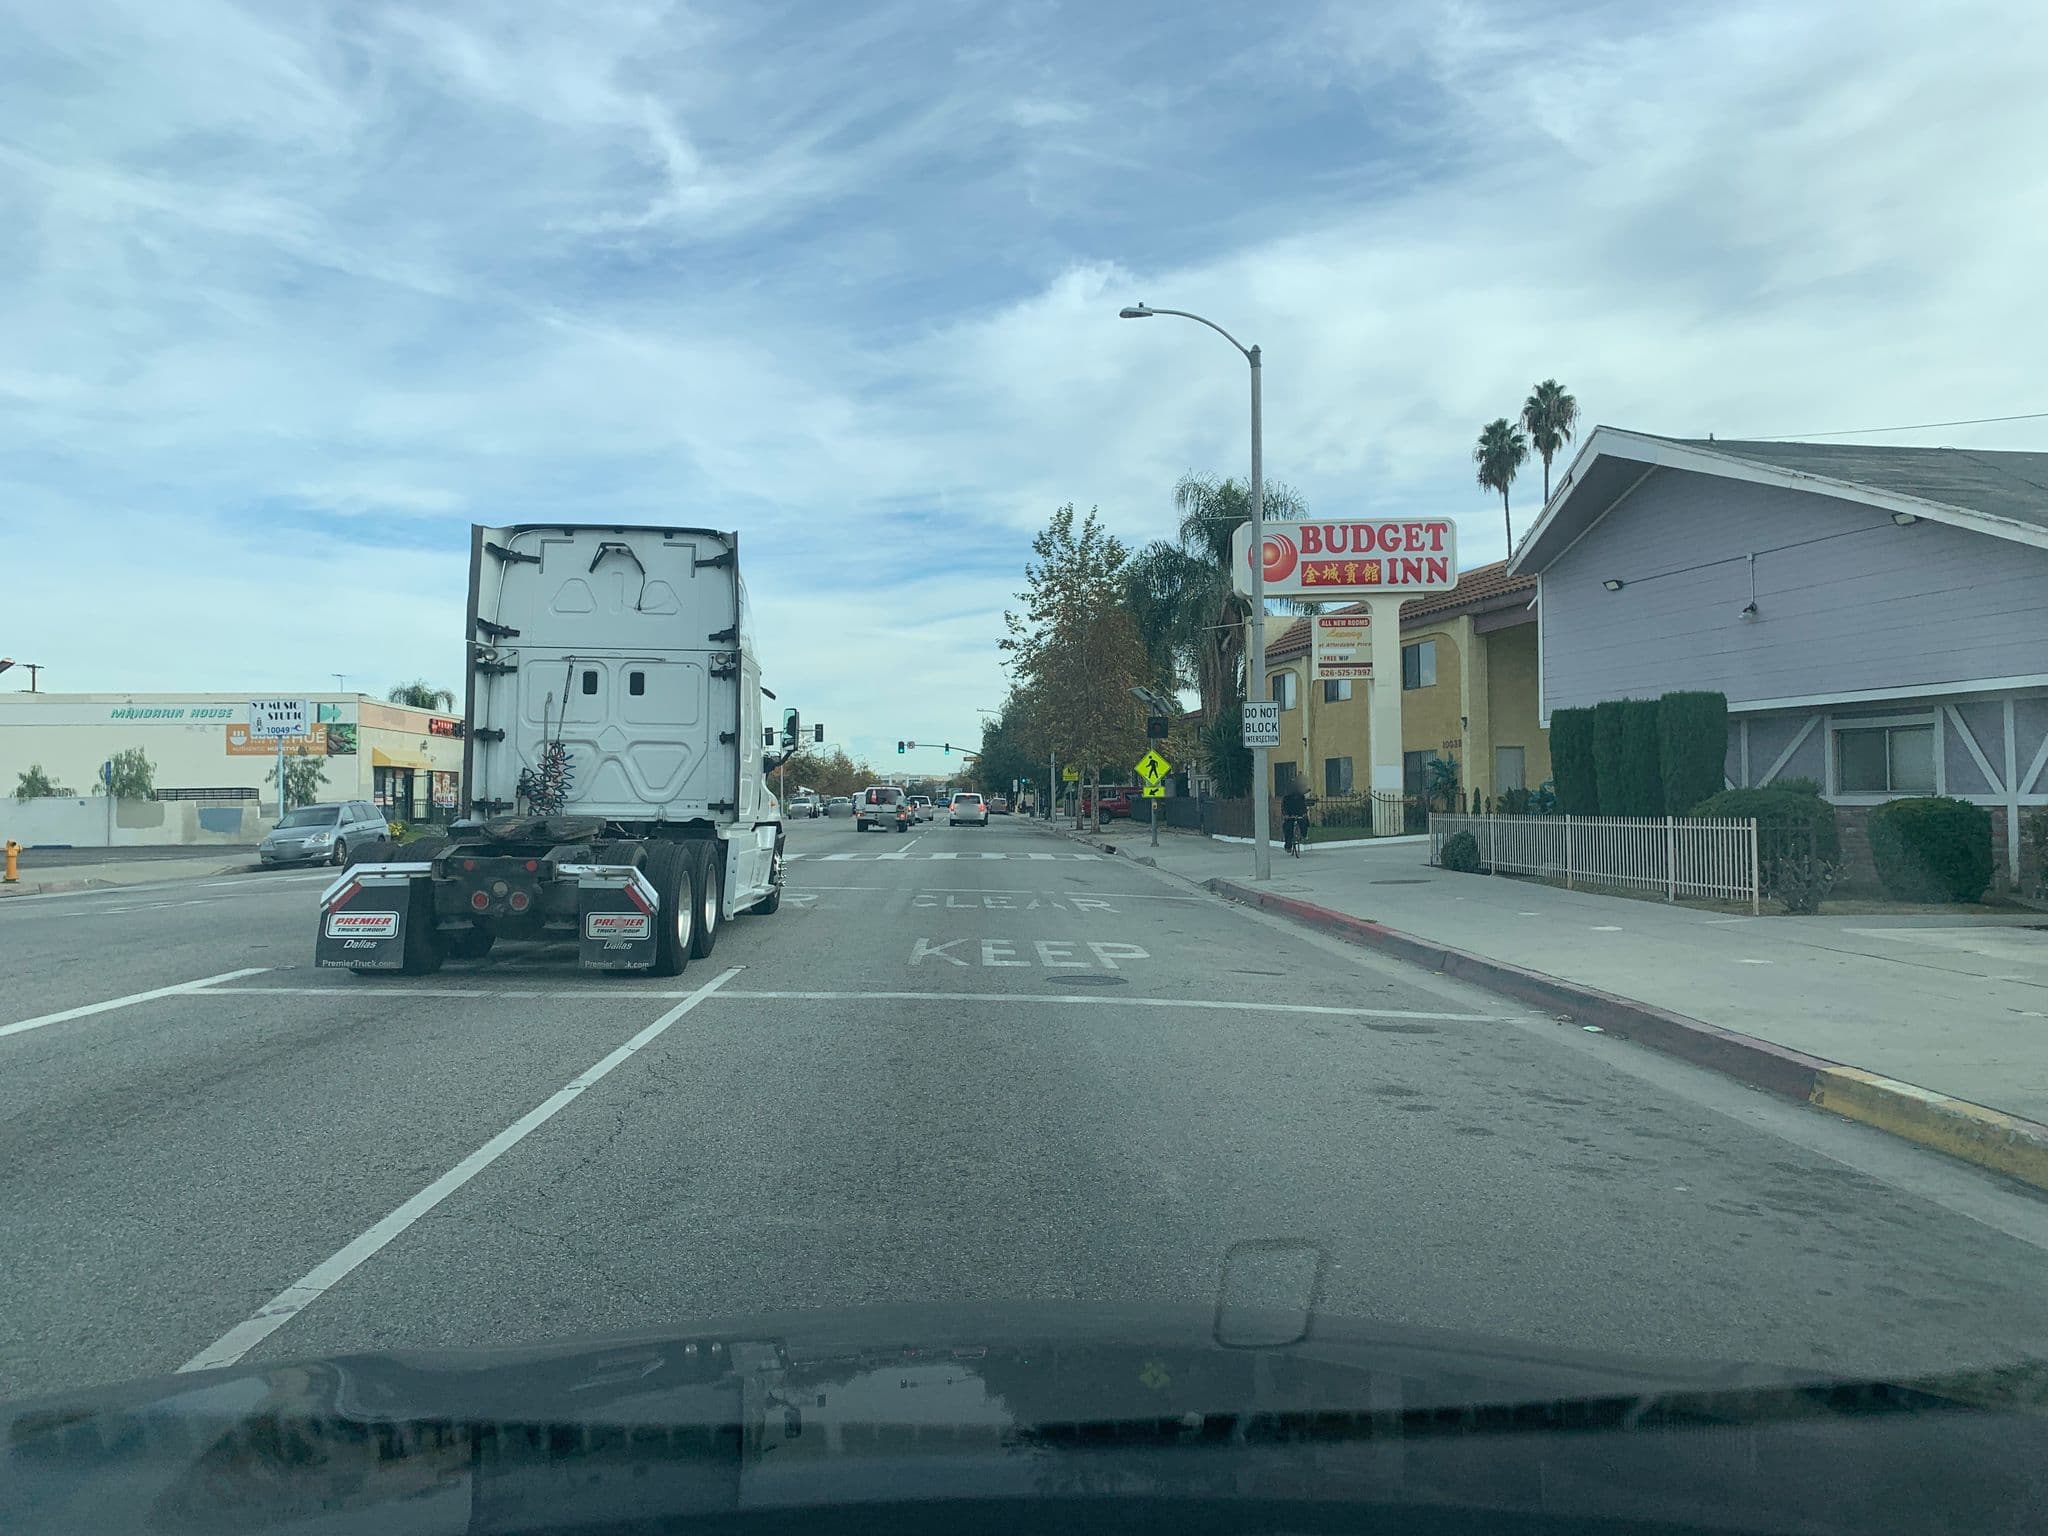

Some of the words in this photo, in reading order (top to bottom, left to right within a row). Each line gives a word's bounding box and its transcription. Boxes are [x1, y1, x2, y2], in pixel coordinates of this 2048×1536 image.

[1299, 523, 1448, 554] BUDGET
[1386, 557, 1448, 584] INN
[1333, 619, 1346, 627] NEW
[111, 708, 185, 719] MANDARIN
[190, 708, 234, 718] HOUSE
[268, 711, 304, 720] STUDIO
[1245, 707, 1257, 718] DO
[1260, 707, 1278, 718] NOT
[266, 726, 290, 734] 10049
[1245, 722, 1278, 733] BLOCK
[911, 894, 1121, 913] CLEAR
[335, 917, 392, 925] PREMIER
[343, 939, 378, 949] Dallas
[907, 937, 1151, 969] KEEP
